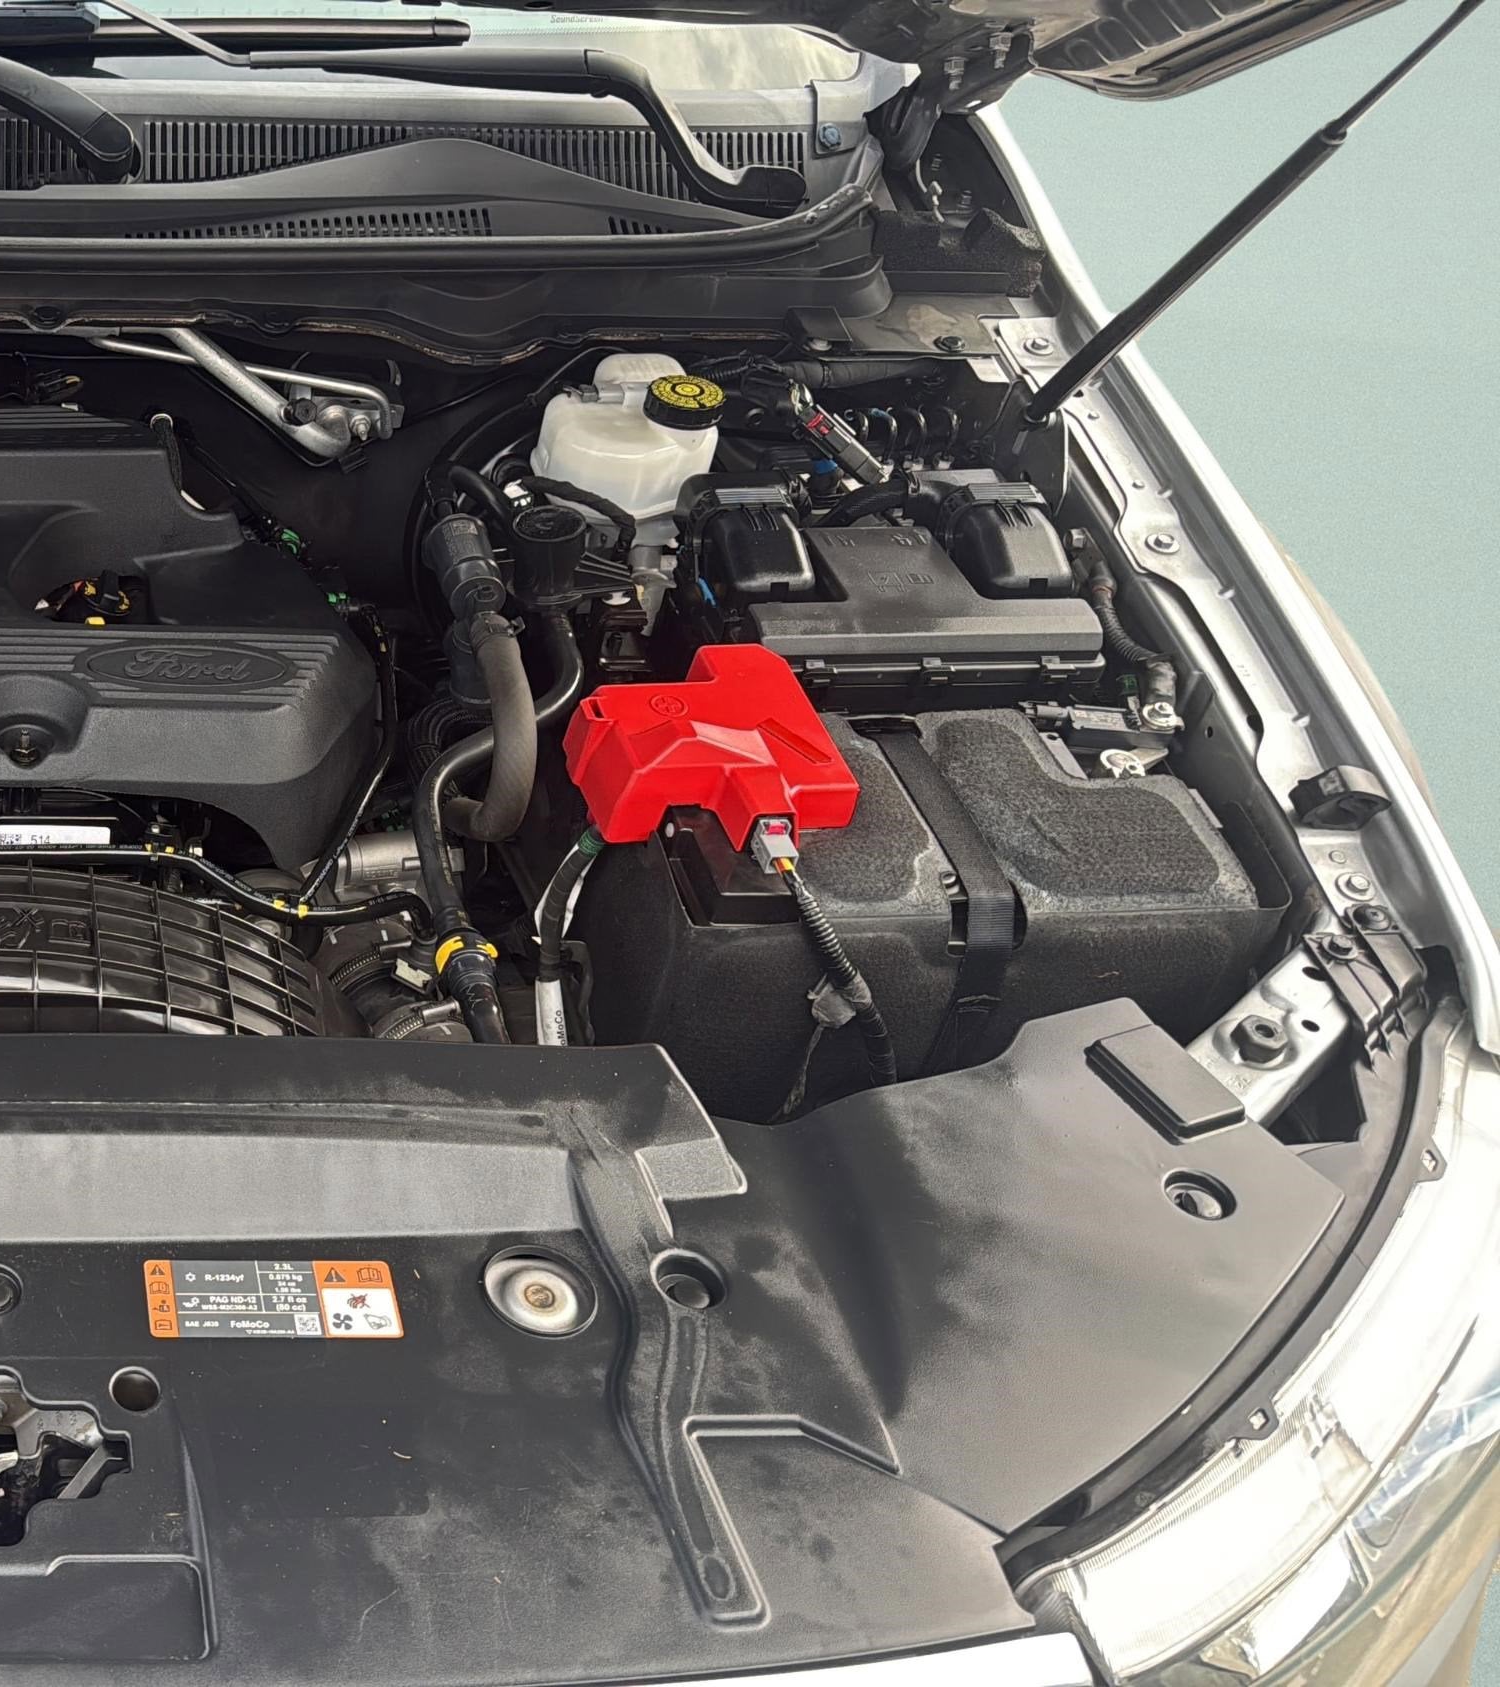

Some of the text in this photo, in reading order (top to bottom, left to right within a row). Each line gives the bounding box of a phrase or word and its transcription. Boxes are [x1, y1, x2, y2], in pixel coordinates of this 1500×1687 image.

[124, 647, 252, 682] Ford
[554, 1010, 566, 1046] oMoCo
[204, 1273, 245, 1283] R-1234yf
[209, 1296, 229, 1304] PAG
[229, 1320, 270, 1329] FoMoCo
